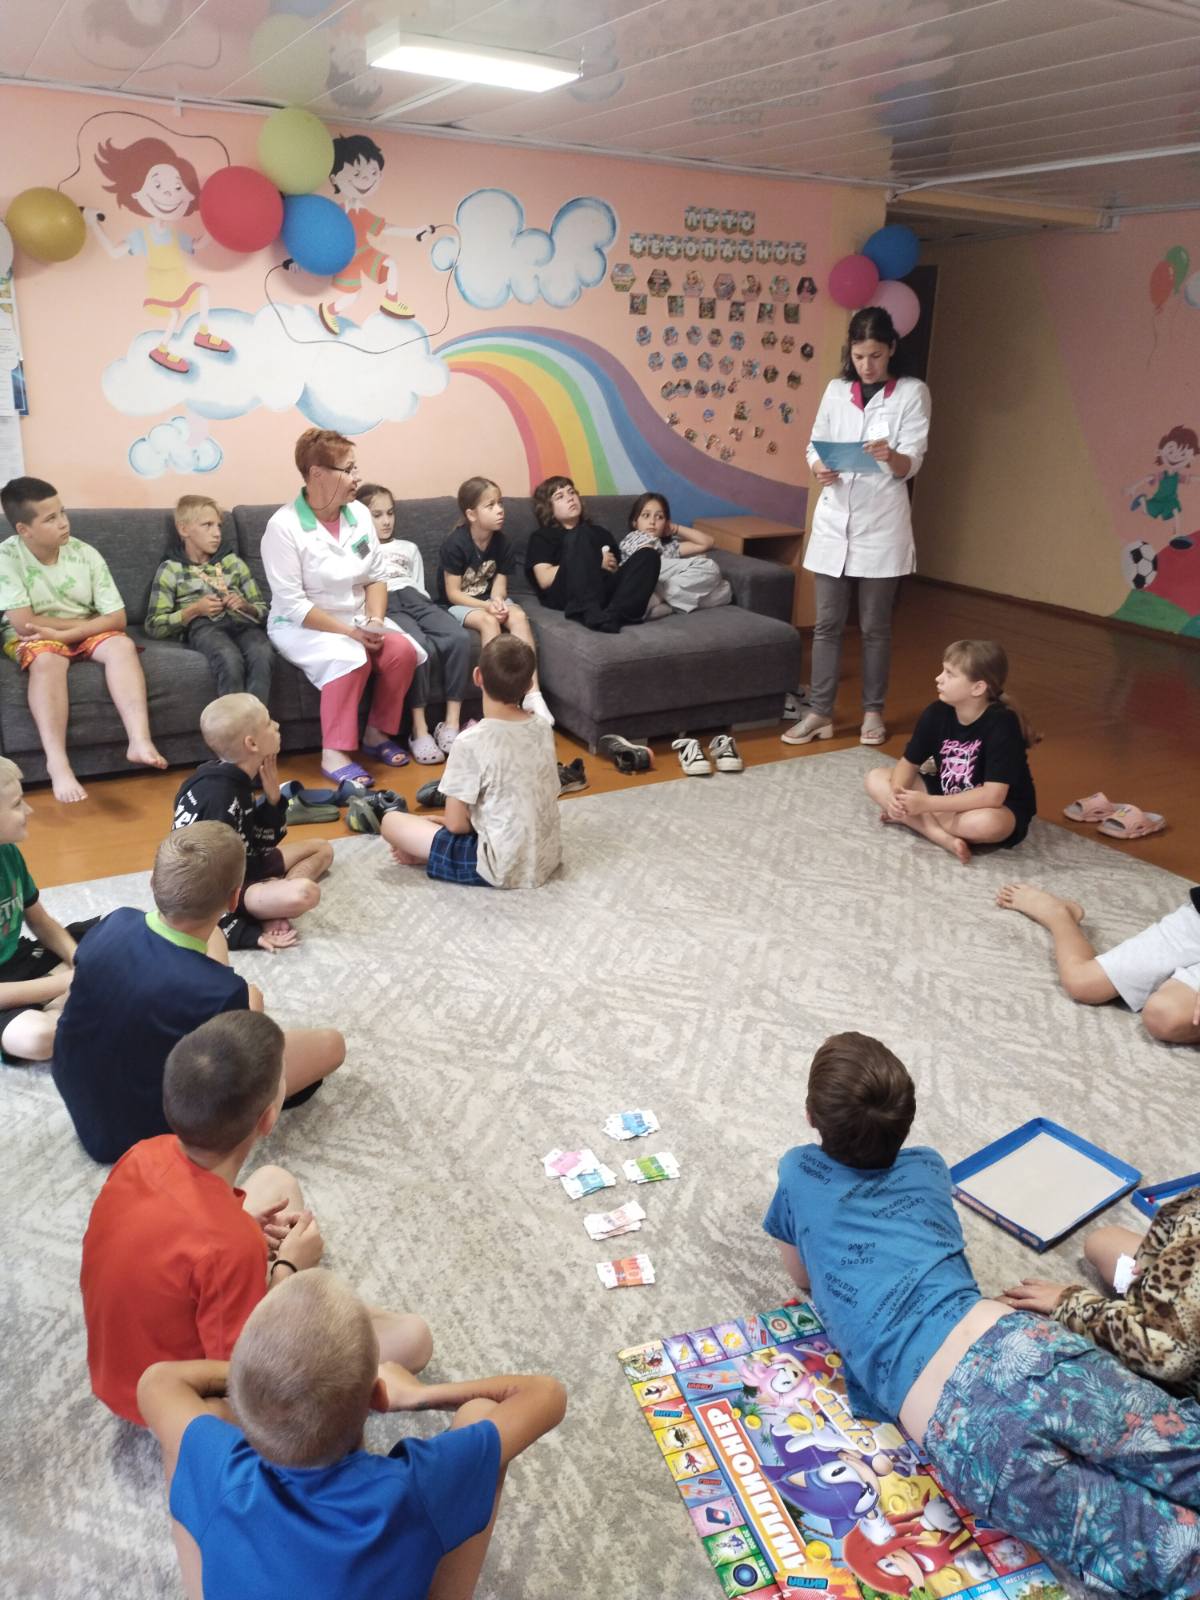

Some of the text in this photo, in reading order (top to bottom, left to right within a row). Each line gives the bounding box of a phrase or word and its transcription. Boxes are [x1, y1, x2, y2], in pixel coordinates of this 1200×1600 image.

[685, 211, 754, 231] ЛЕТО
[632, 237, 804, 260] БЕЗОПАСНОЕ
[815, 1389, 877, 1453] СУПЕР
